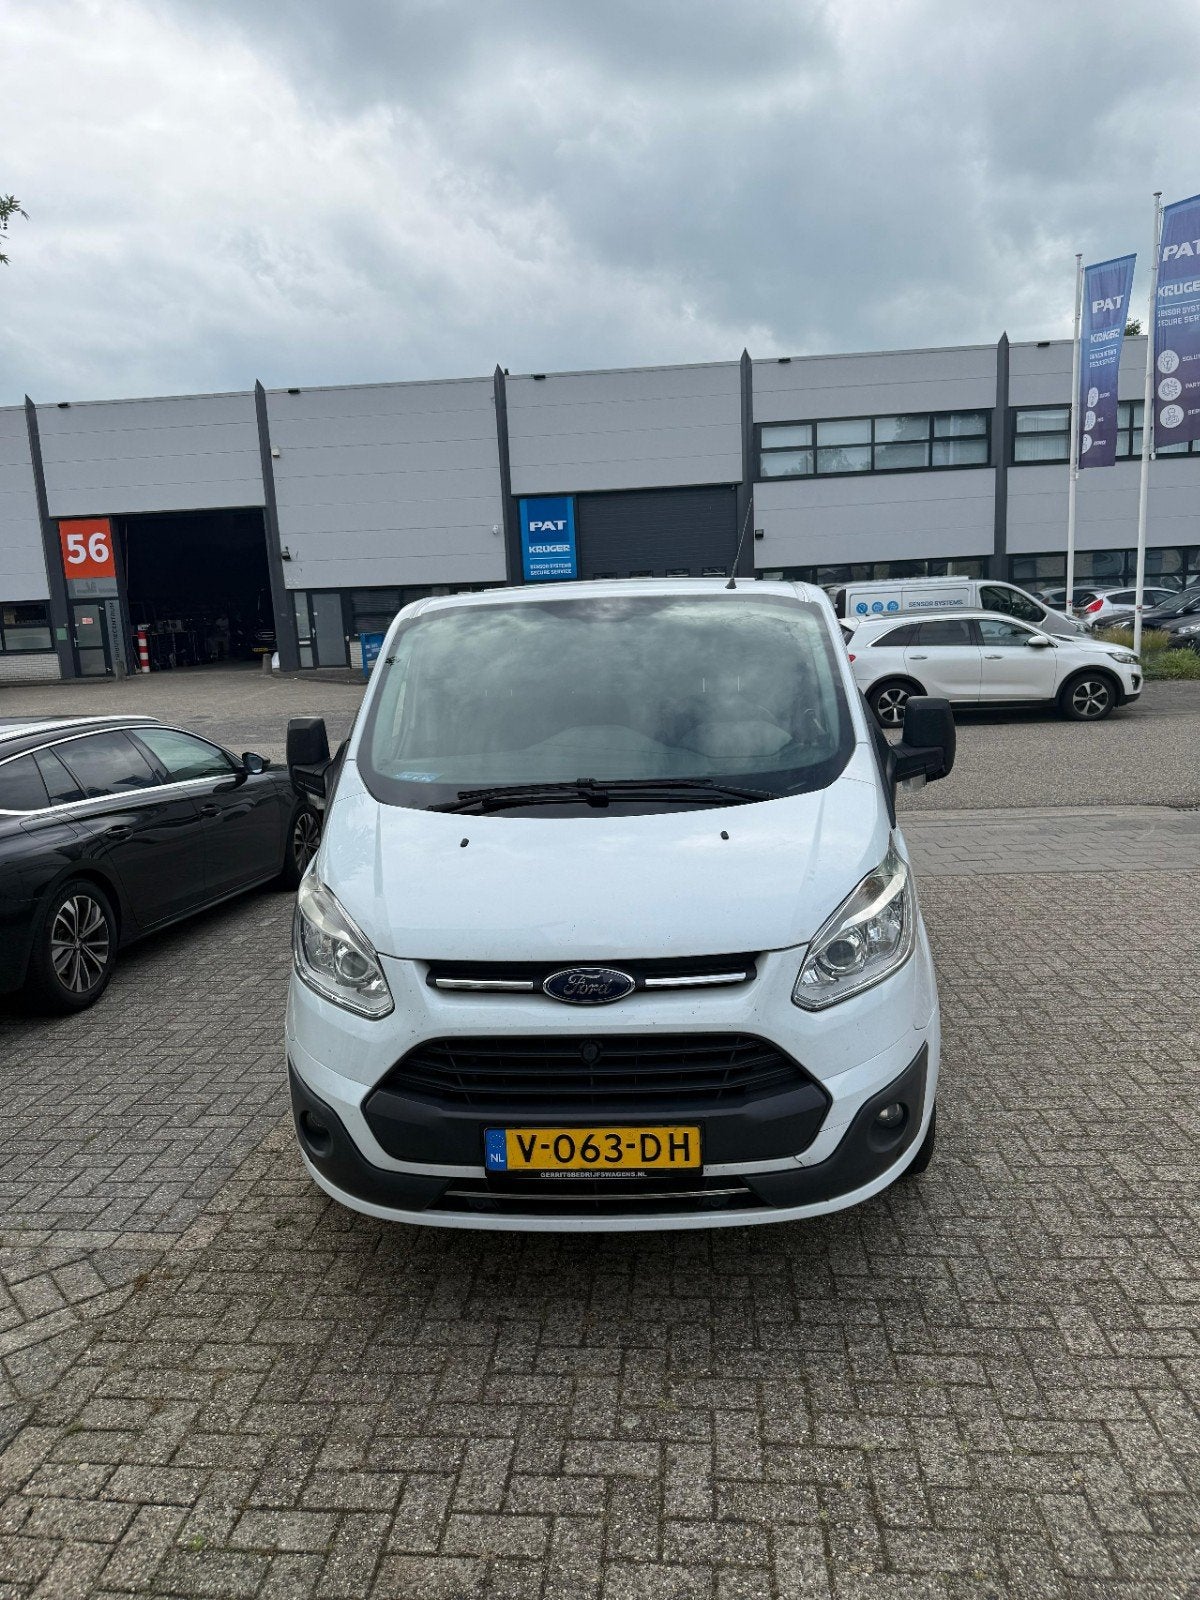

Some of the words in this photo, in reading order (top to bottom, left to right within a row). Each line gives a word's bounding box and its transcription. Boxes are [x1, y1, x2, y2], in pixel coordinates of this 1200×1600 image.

[1092, 295, 1124, 314] PAT
[529, 520, 567, 532] PAT
[67, 533, 109, 564] 56
[563, 974, 613, 995] Ford
[490, 1153, 505, 1163] NL
[516, 1133, 690, 1164] V-063-DH
